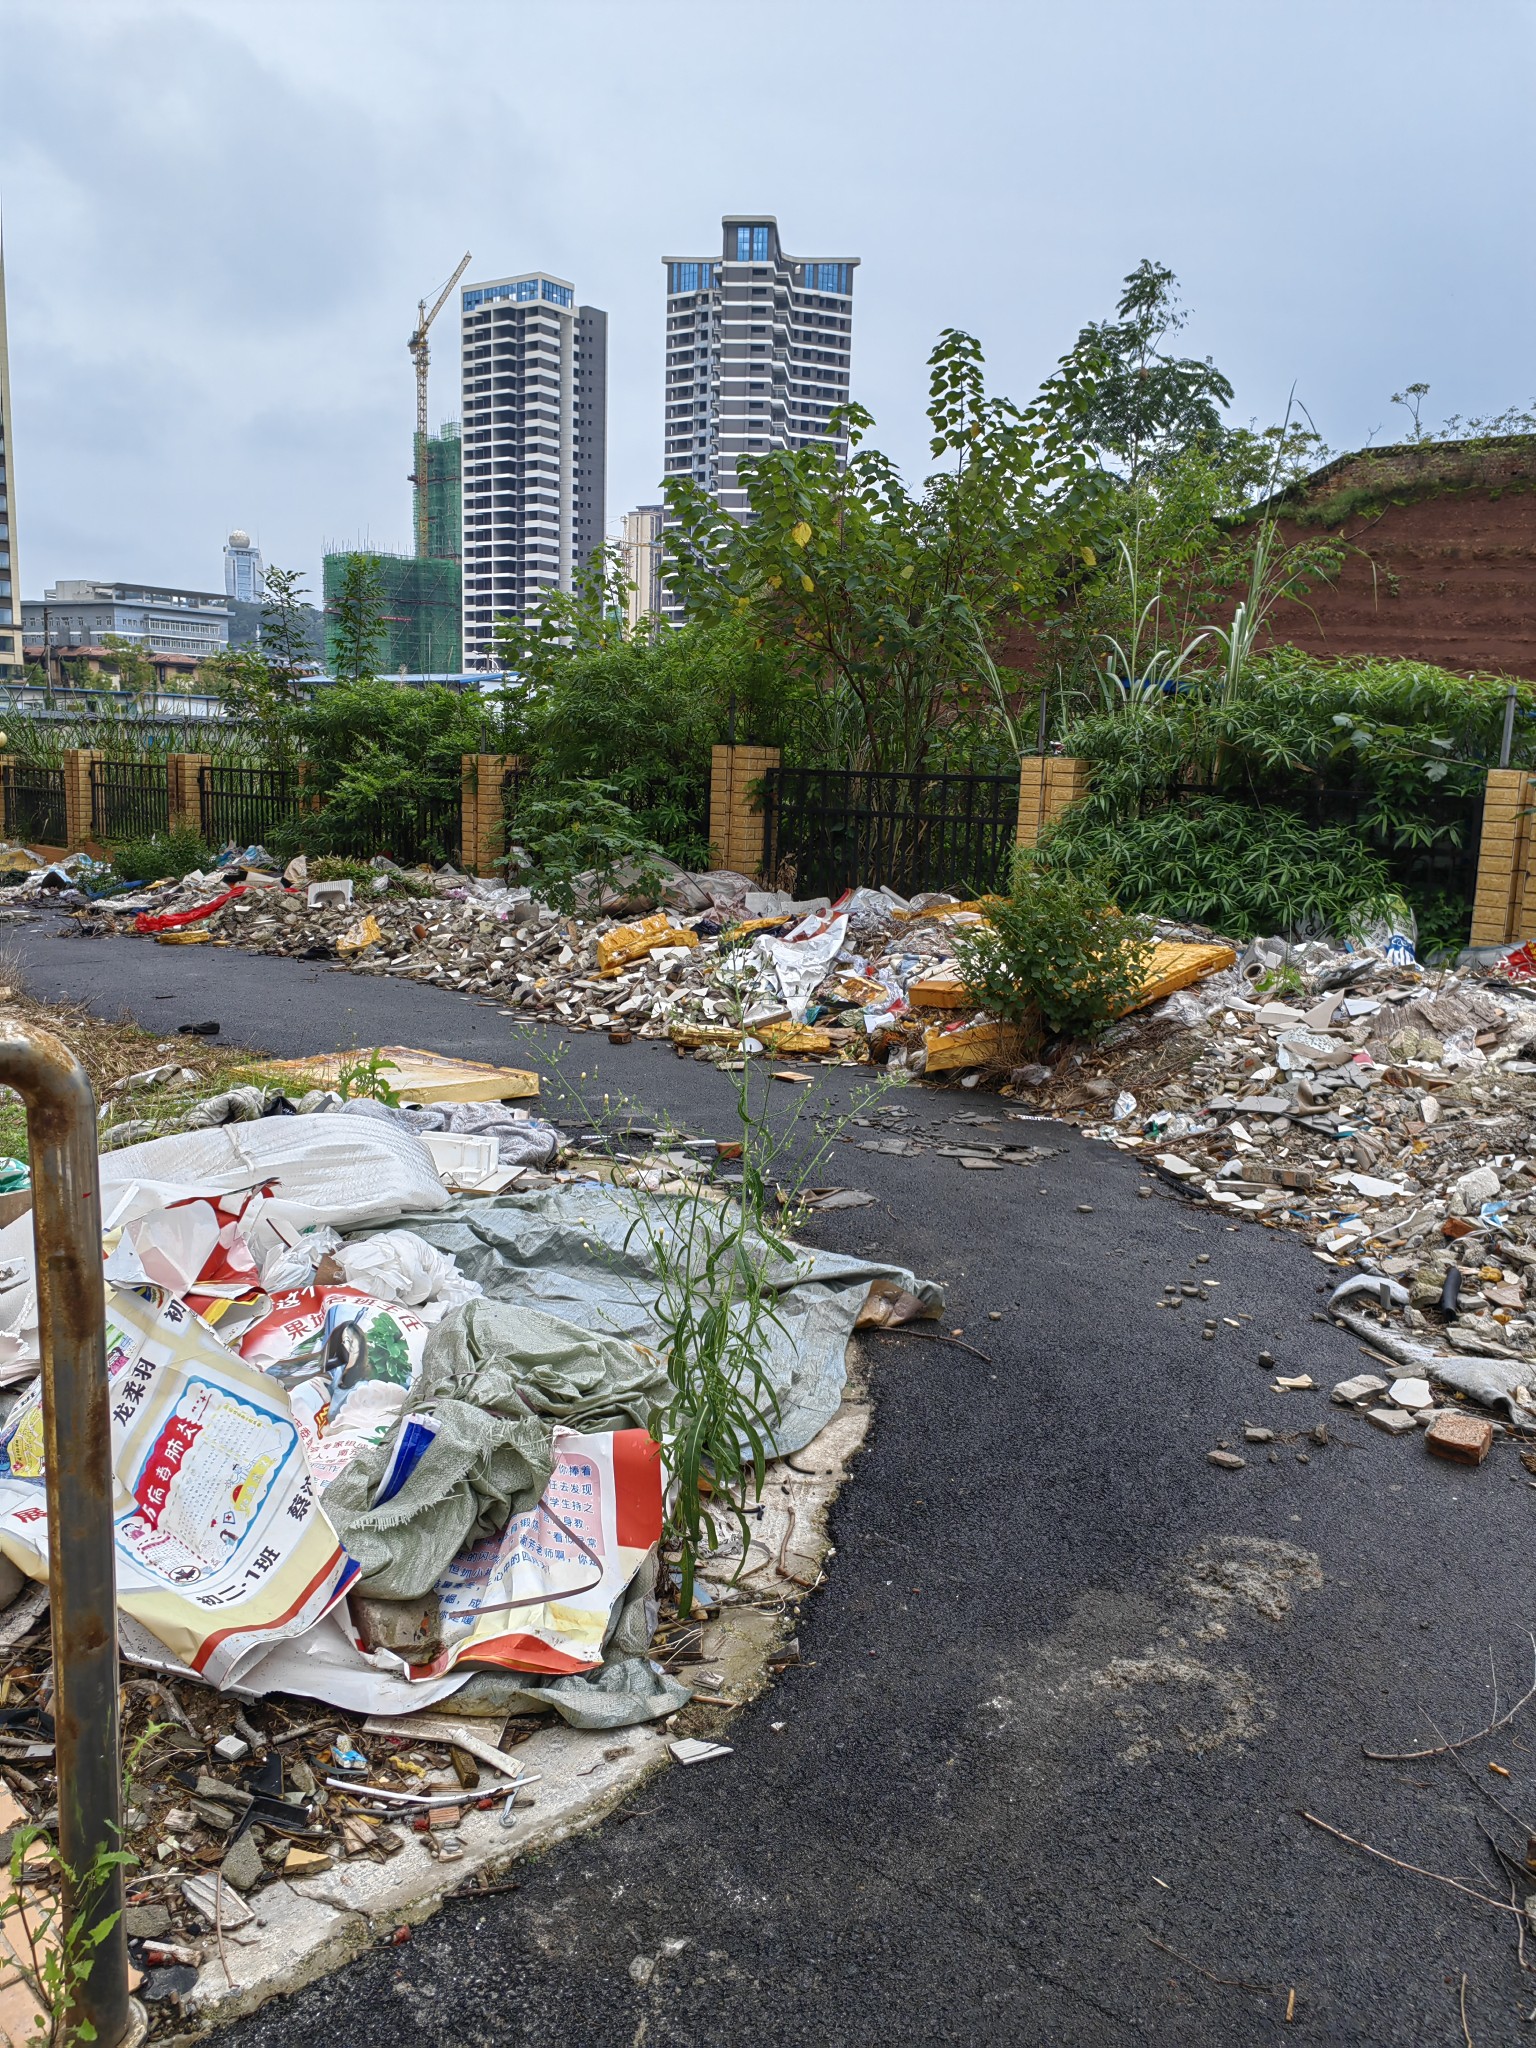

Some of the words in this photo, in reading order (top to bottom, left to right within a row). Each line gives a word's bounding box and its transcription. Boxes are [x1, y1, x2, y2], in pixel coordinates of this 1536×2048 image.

[164, 1299, 187, 1322] 初
[113, 1357, 157, 1427] 龙柔羽
